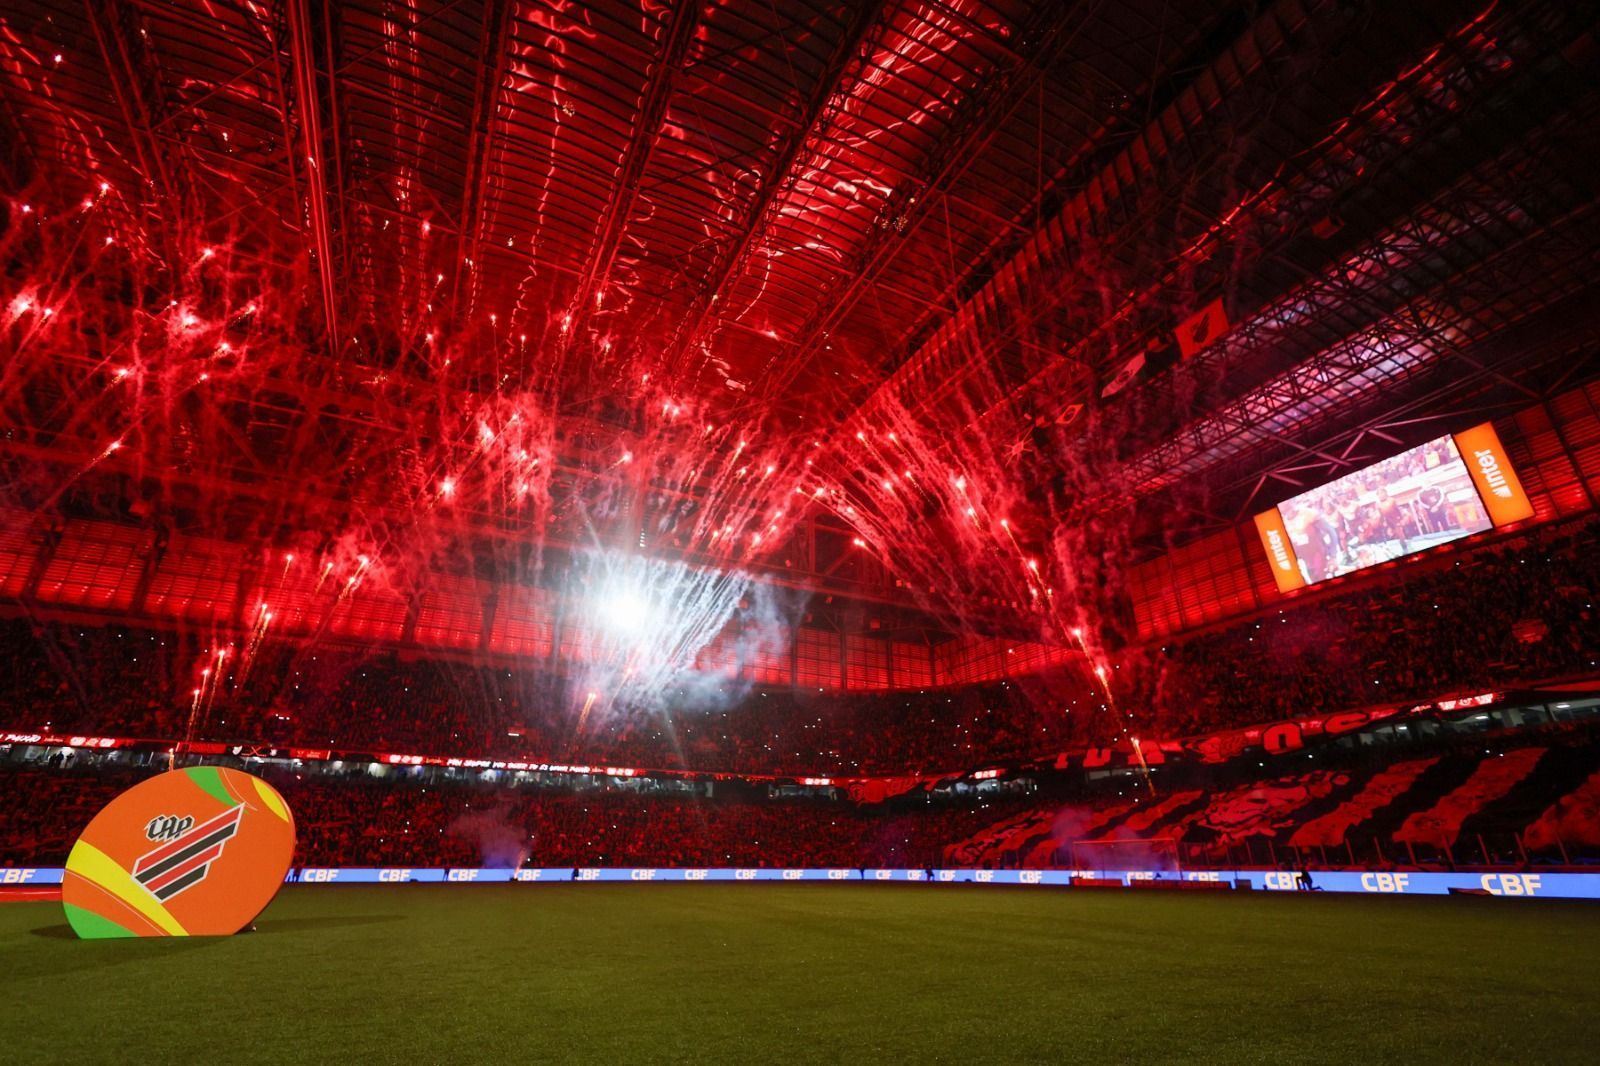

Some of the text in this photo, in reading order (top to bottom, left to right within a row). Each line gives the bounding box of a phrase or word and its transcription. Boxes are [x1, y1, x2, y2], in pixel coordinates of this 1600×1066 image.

[1474, 449, 1506, 488] inter
[1266, 530, 1288, 562] inter
[303, 868, 340, 883] CBF
[378, 869, 411, 882] CBF
[447, 868, 479, 882] CBF
[631, 868, 657, 881] CBF
[684, 869, 709, 880] CBF
[734, 869, 760, 880] CBF
[781, 869, 805, 880] CBF
[828, 869, 850, 880] CBF
[975, 869, 994, 882] CBF
[1018, 870, 1043, 884] CBF
[1360, 872, 1409, 893] CBF
[1480, 873, 1542, 897] CBF
